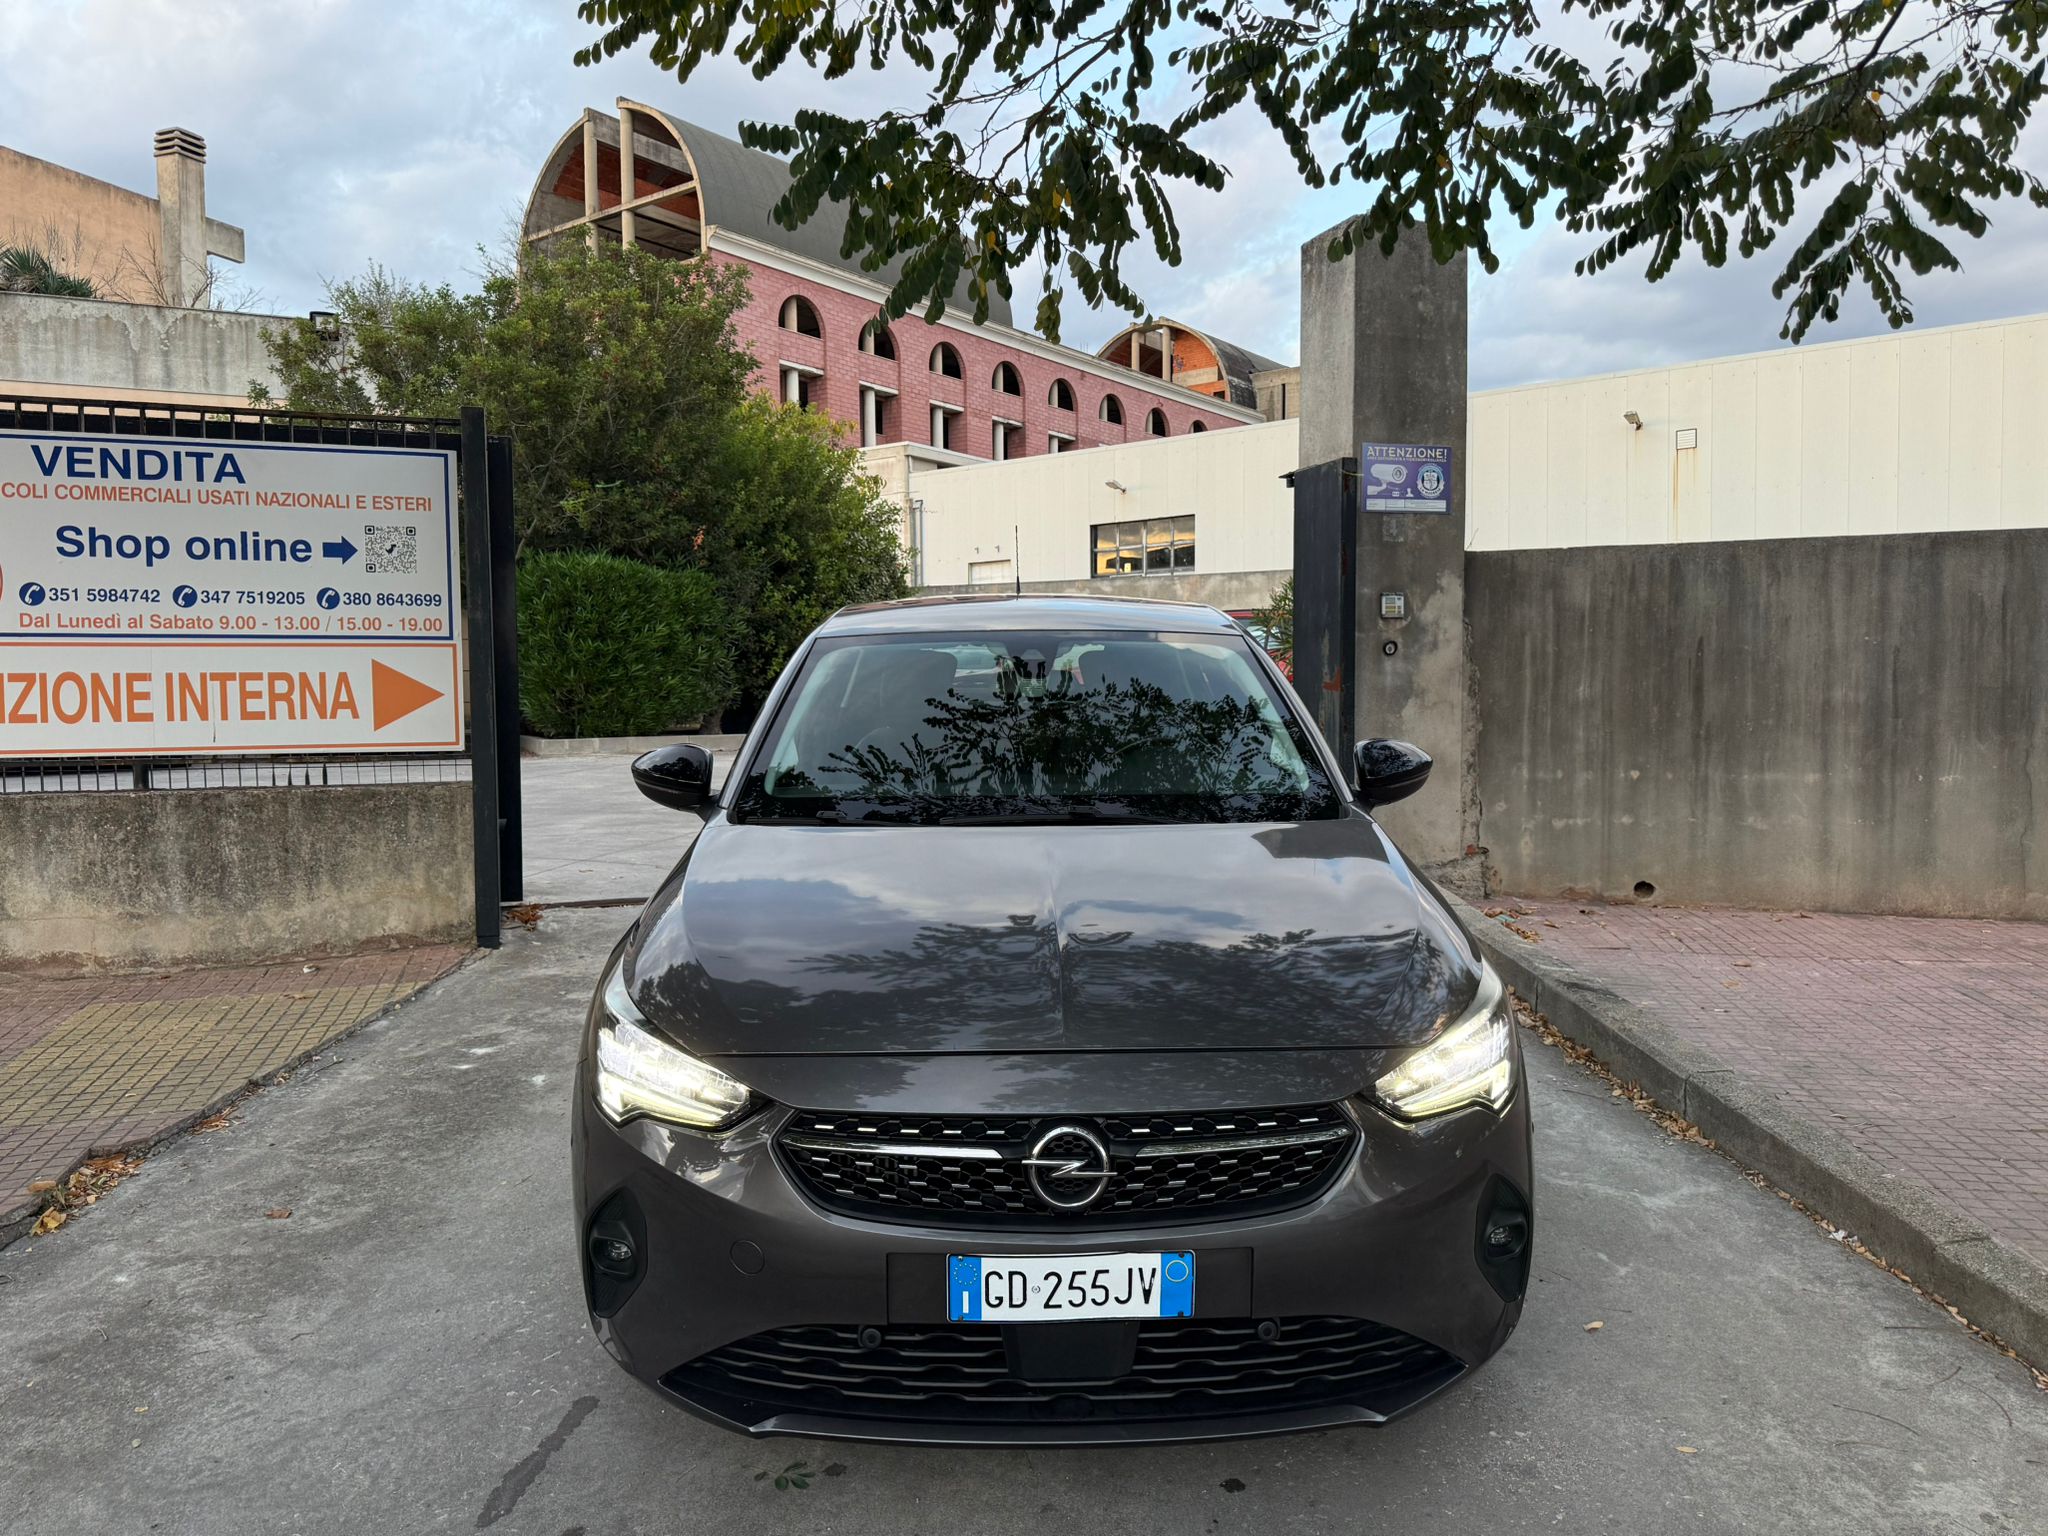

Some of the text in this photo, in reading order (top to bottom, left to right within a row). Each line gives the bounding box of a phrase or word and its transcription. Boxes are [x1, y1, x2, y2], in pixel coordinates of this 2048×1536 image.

[30, 444, 246, 484] VENDITA
[1367, 446, 1447, 459] ATTENZIONE!
[54, 484, 191, 504] COMMERCIALI
[197, 489, 250, 506] USATI
[255, 491, 350, 509] NAZIONALI
[355, 495, 367, 510] E
[372, 495, 432, 512] ESTERI
[56, 525, 312, 567] Shop online
[48, 587, 160, 603] 351 5984742
[200, 590, 305, 605] 347 7519205
[343, 592, 442, 607] 380 8643699
[19, 613, 49, 628] Dal
[57, 613, 120, 629] Lunedì
[127, 614, 143, 629] al
[149, 614, 214, 630] Sabato
[219, 616, 257, 630] 9.00
[275, 616, 320, 631] 13.00
[337, 617, 382, 631] 15.00
[399, 618, 443, 632] 19.00
[165, 671, 360, 722] INTERNA
[984, 1267, 1157, 1309] GD 255JV
